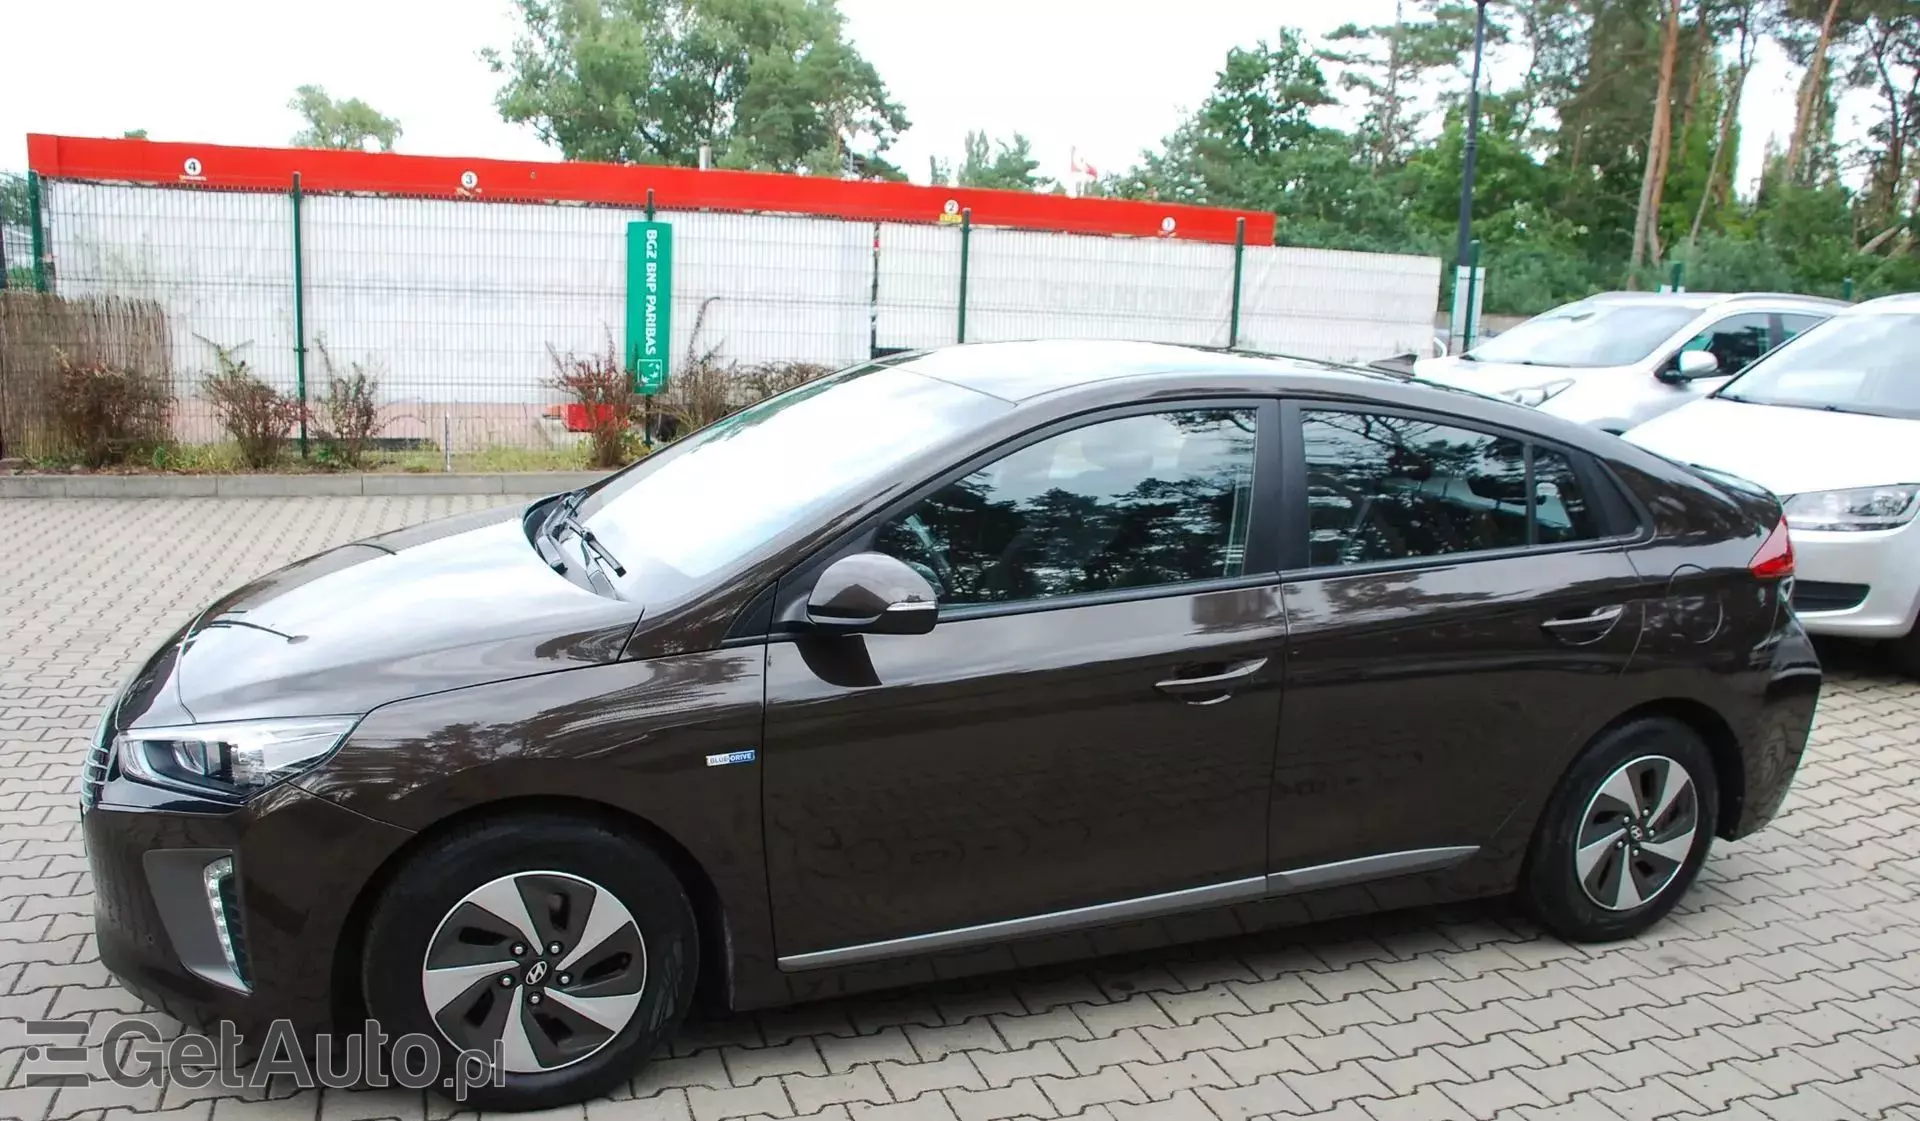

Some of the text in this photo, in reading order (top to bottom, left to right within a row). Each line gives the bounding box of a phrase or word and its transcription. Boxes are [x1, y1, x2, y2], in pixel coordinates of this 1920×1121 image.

[465, 174, 473, 185] 3
[645, 262, 657, 292] BNP
[645, 295, 657, 355] PARIBAS
[730, 752, 752, 762] DRIVE
